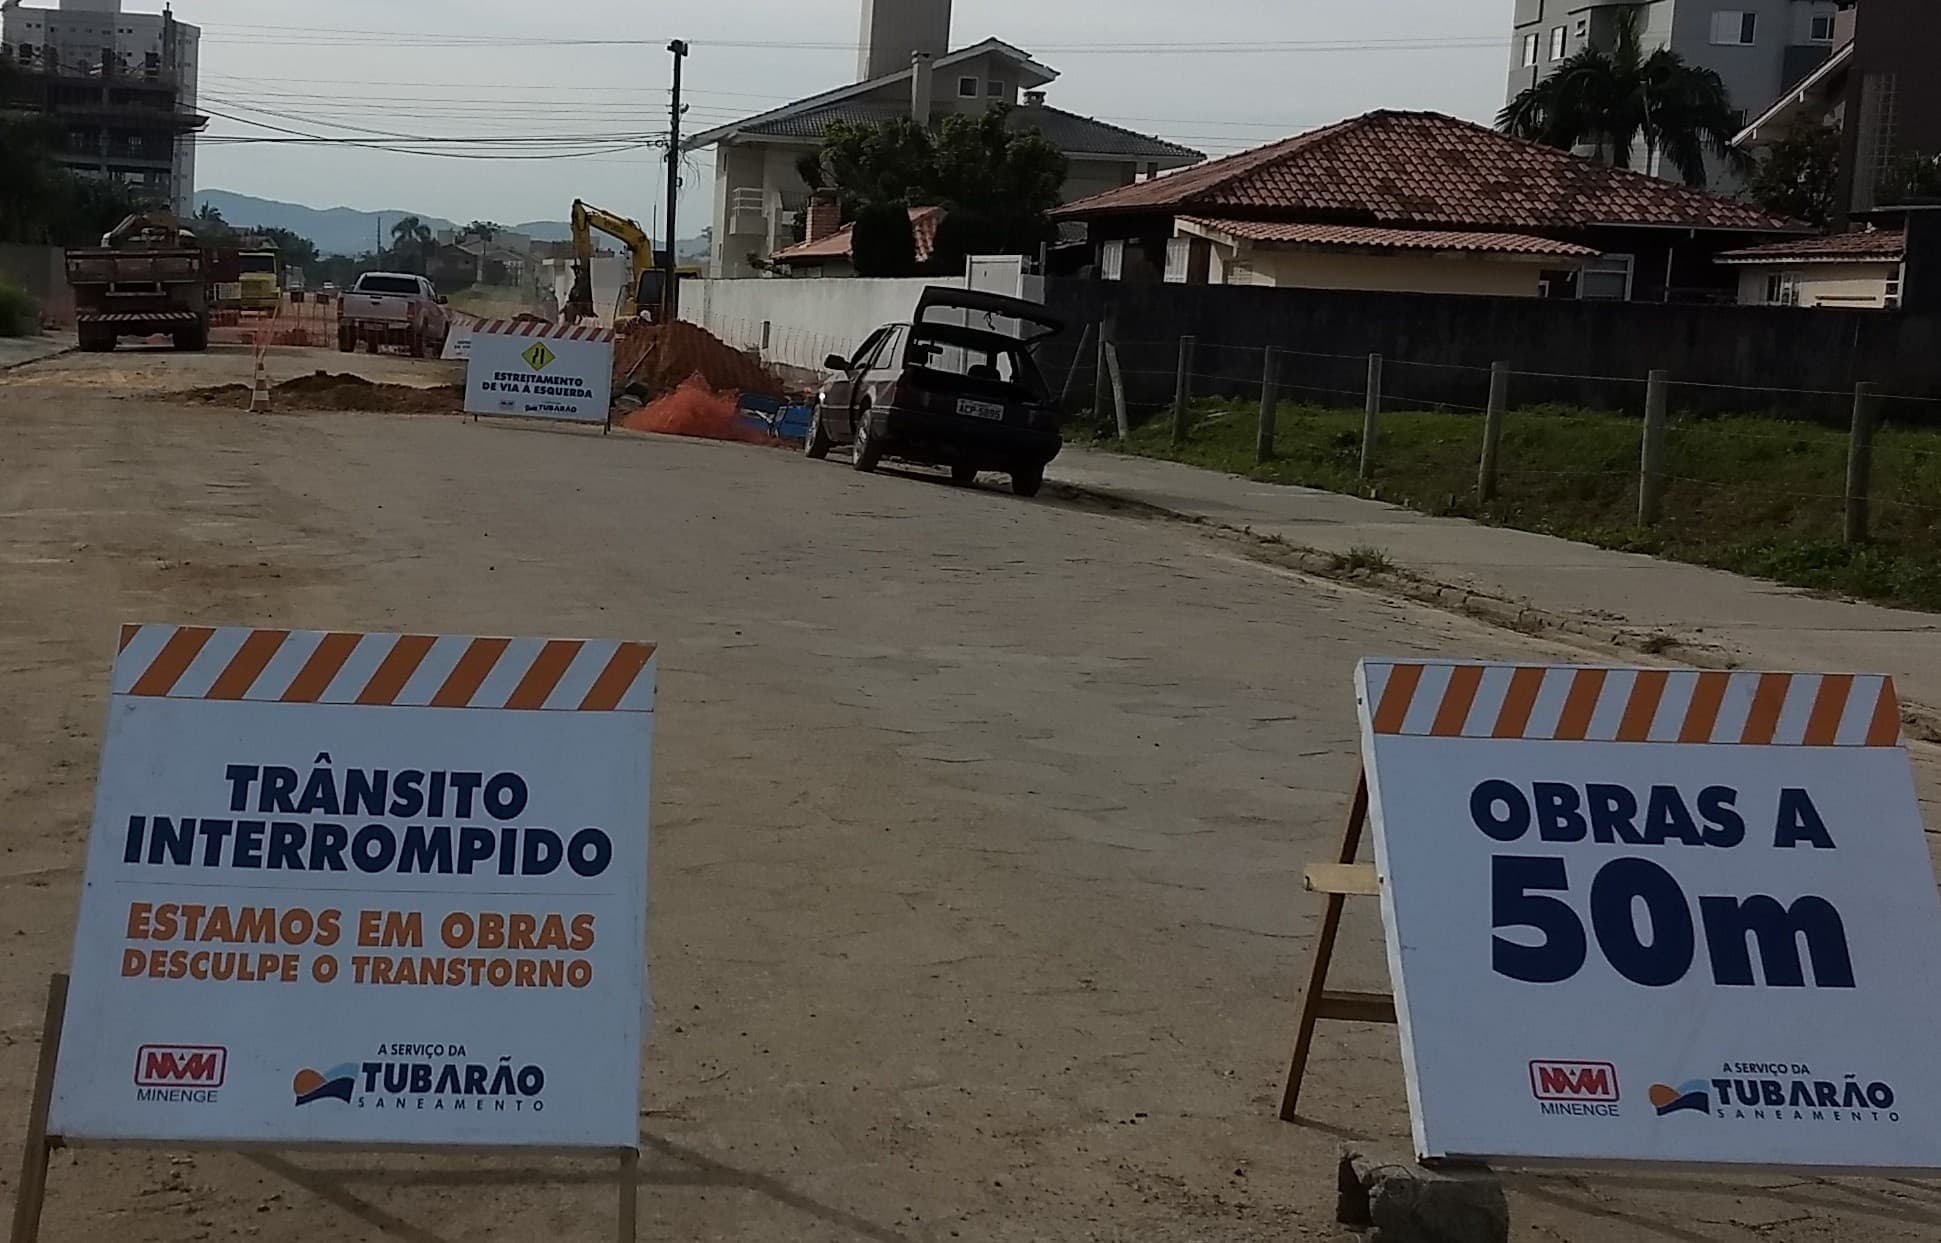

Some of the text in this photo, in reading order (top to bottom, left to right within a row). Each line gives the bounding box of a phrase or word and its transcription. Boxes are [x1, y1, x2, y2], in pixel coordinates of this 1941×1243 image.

[482, 381, 496, 391] DE
[500, 382, 519, 393] VIA
[533, 385, 593, 399] ESQUERDA
[494, 371, 584, 387] ESTREITAMENTO
[225, 752, 528, 821] TRÂNSITO
[1469, 779, 1837, 849] OBRAS A
[123, 815, 613, 878] INTERROMPIDO
[126, 902, 596, 951] ESTAMOS EM OBRAS
[1491, 854, 1857, 989] 50m
[121, 948, 594, 989] DESCULPE O TRANSTORNO
[378, 1043, 467, 1059] A SERVIÇO DA
[362, 1056, 545, 1096] TUBARÃO
[1723, 1062, 1811, 1076] A SERVIÇO DA
[137, 1087, 219, 1103] MINENGE
[358, 1096, 544, 1112] SANEAMENTO
[1711, 1074, 1895, 1109] TUBARÃO
[1540, 1102, 1621, 1117] MINENGE
[1717, 1108, 1900, 1122] SANEAMENTO
